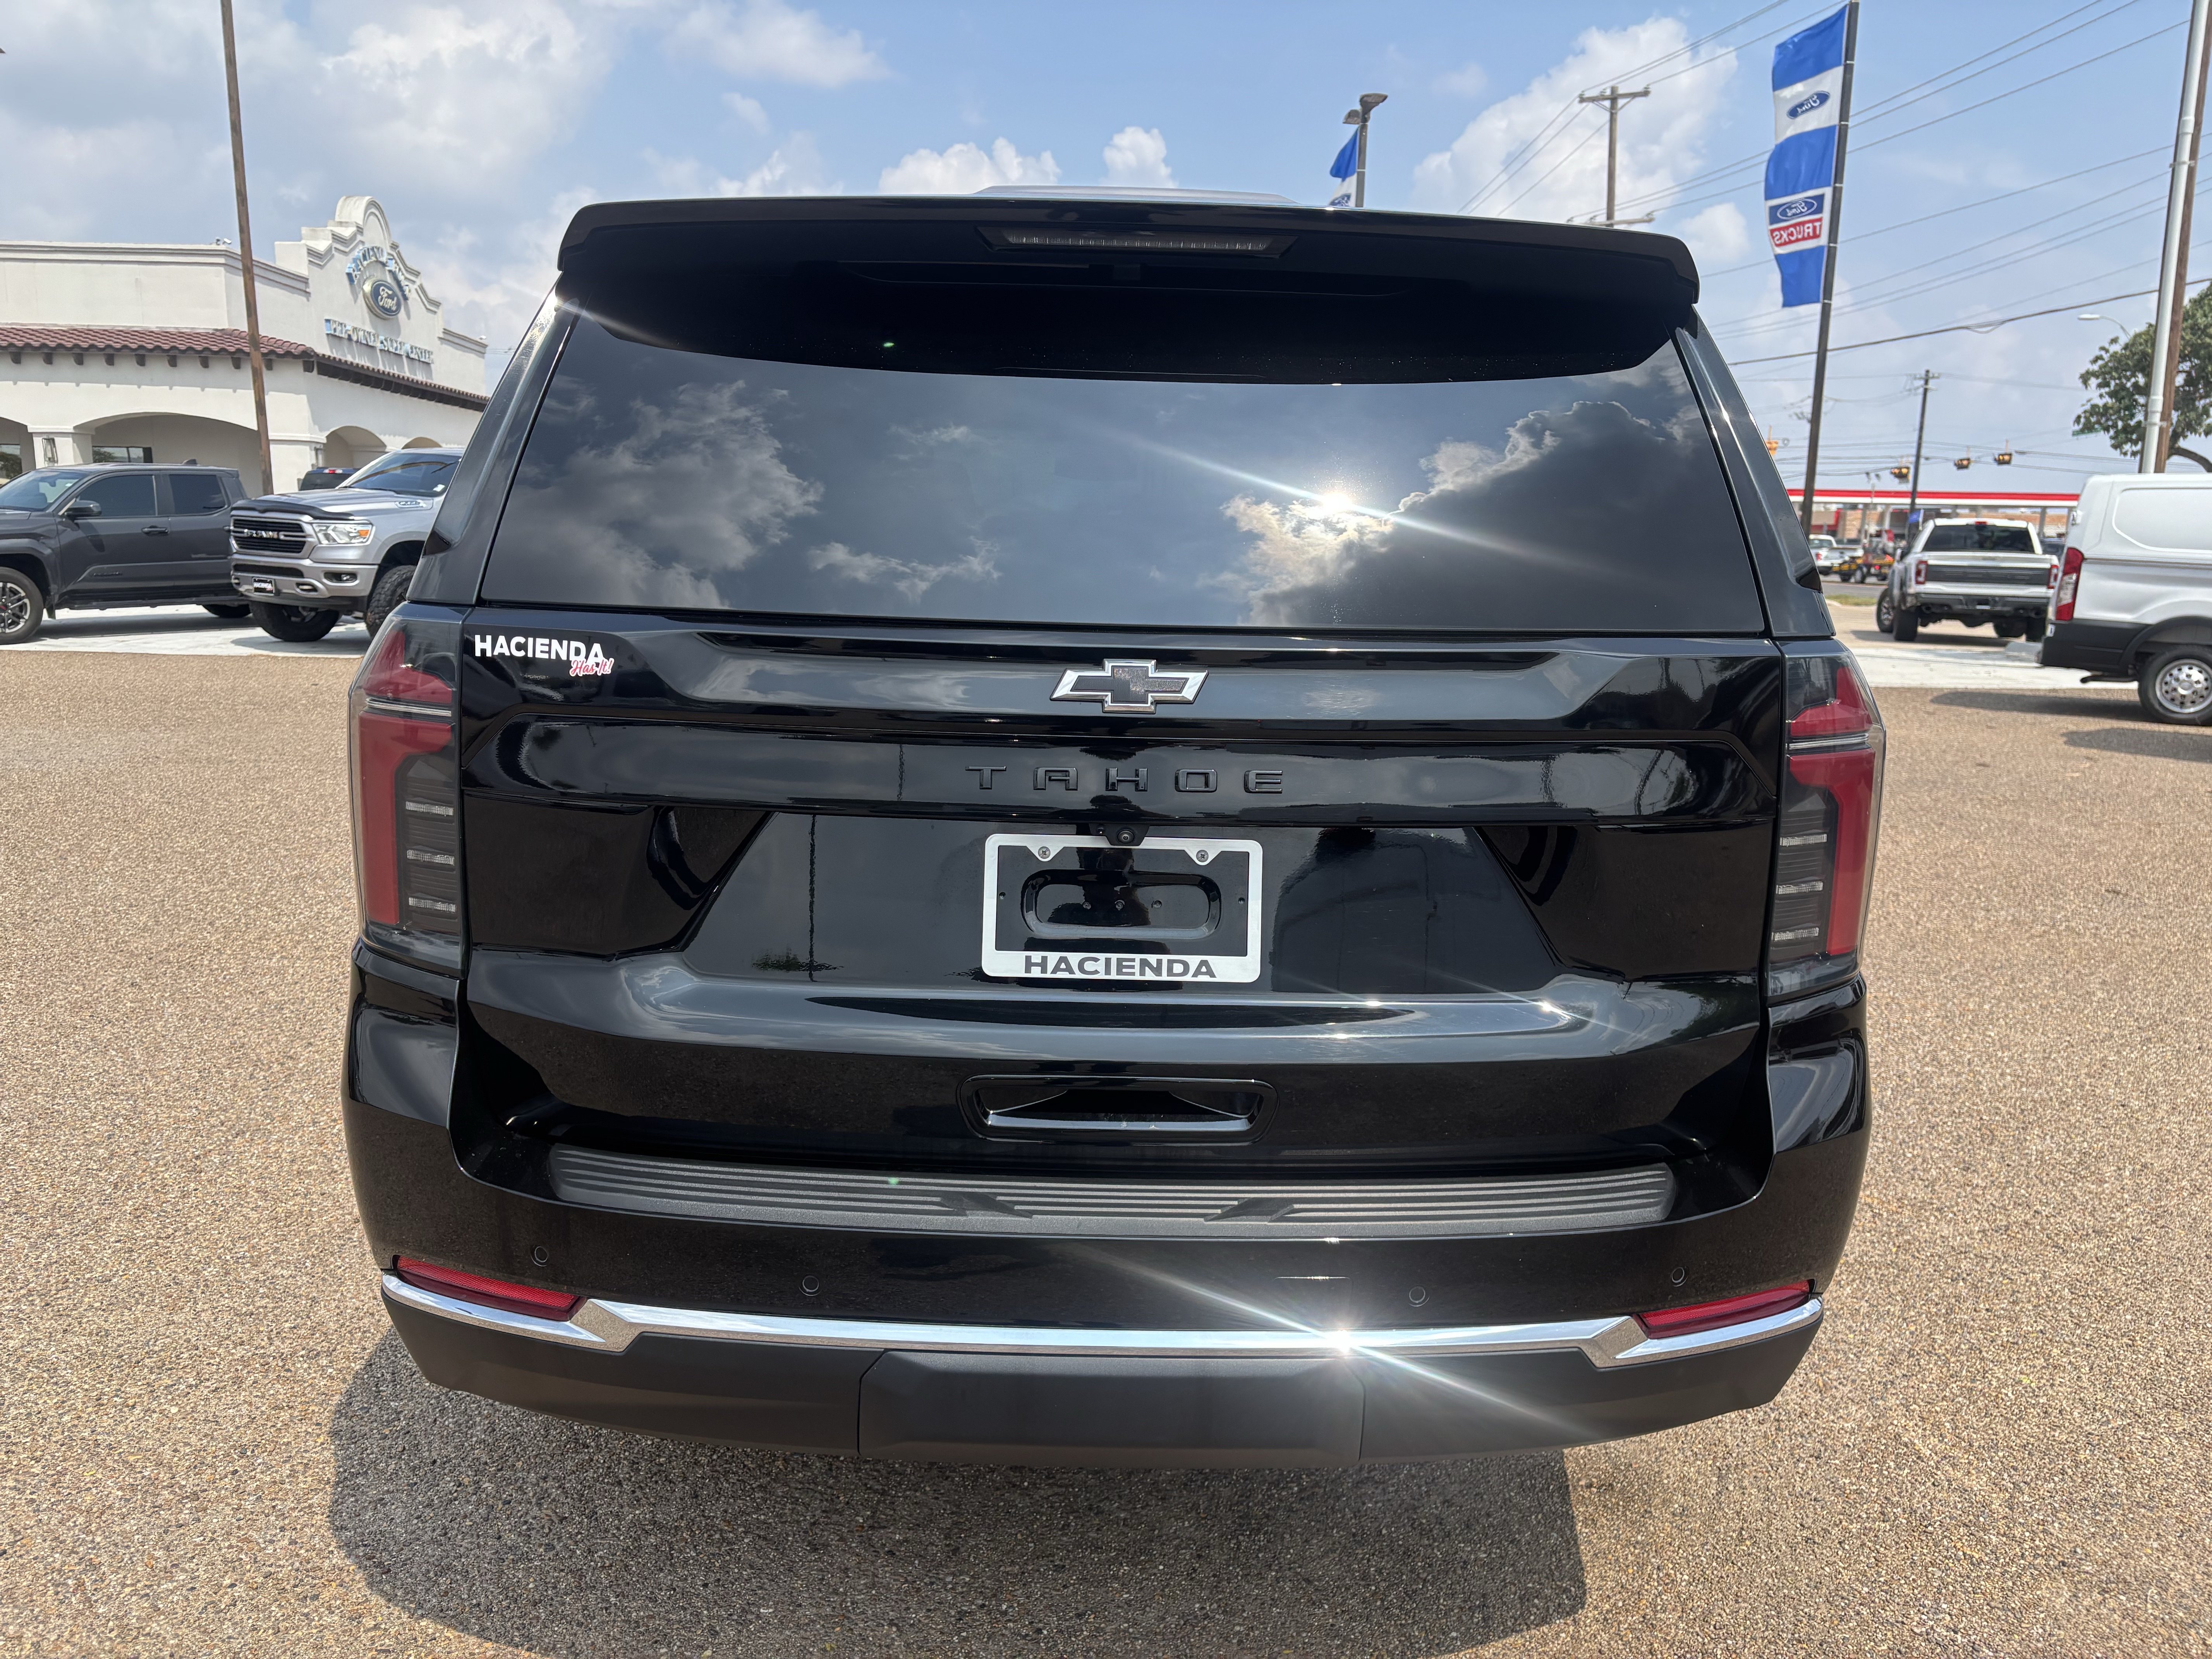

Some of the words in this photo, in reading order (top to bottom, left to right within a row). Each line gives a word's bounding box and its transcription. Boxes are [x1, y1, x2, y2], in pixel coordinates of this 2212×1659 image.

[475, 635, 604, 664] HACIENDA
[571, 659, 596, 675] Has
[598, 659, 613, 674] It!
[965, 766, 1283, 793] TAHOE
[1024, 955, 1216, 978] HACIENDA
